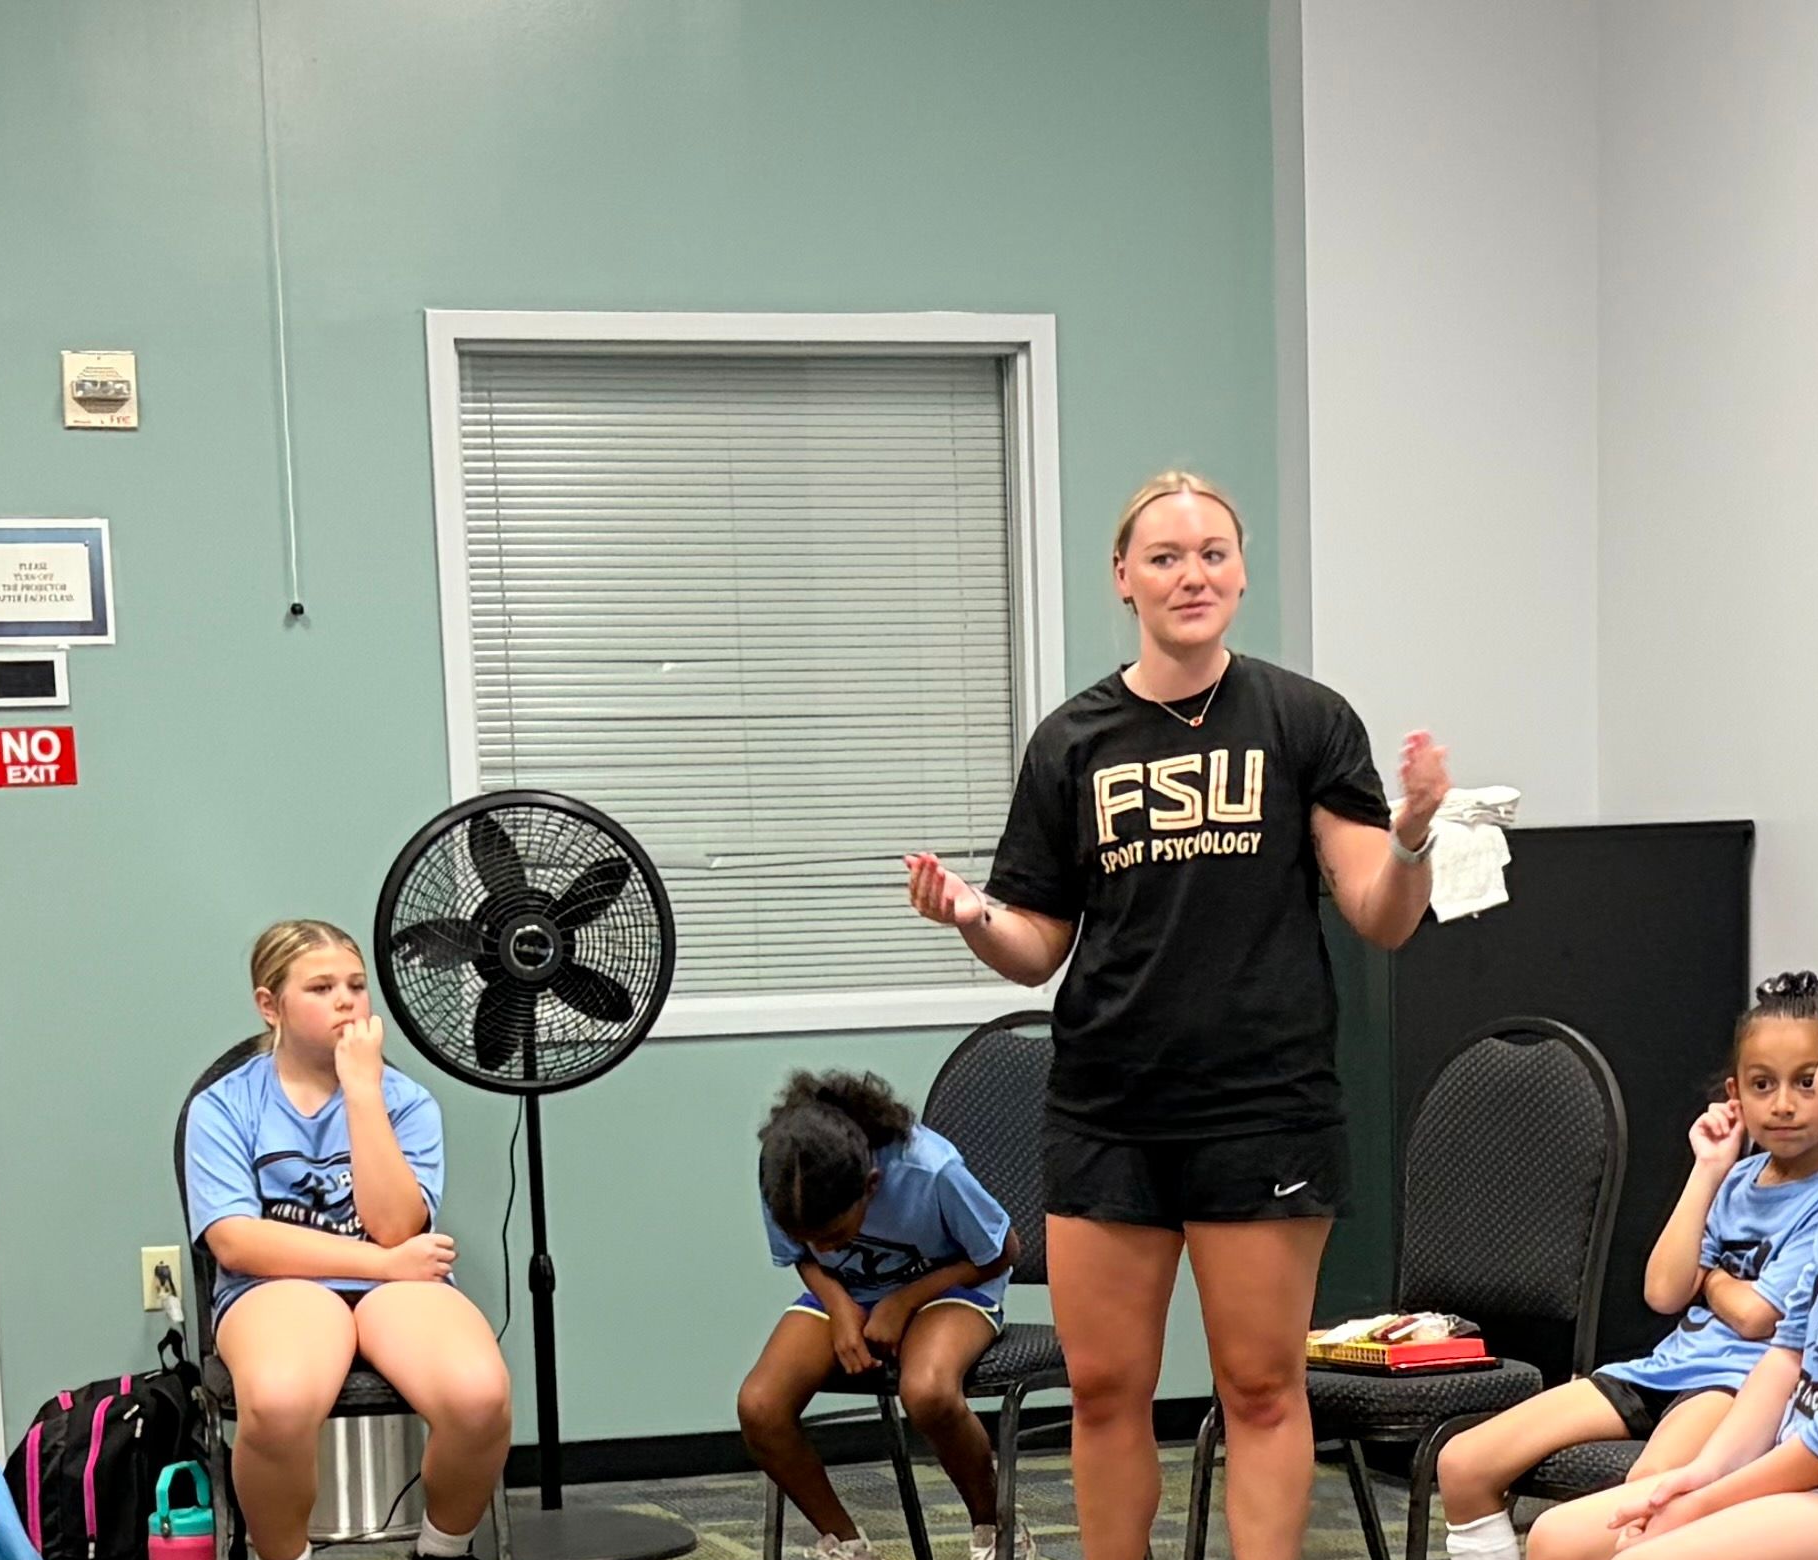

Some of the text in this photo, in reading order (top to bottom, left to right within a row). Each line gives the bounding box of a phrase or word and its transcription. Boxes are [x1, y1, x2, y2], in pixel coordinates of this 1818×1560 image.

[1, 729, 62, 764] NO
[6, 764, 61, 784] EXIT
[1092, 748, 1265, 846] FSU
